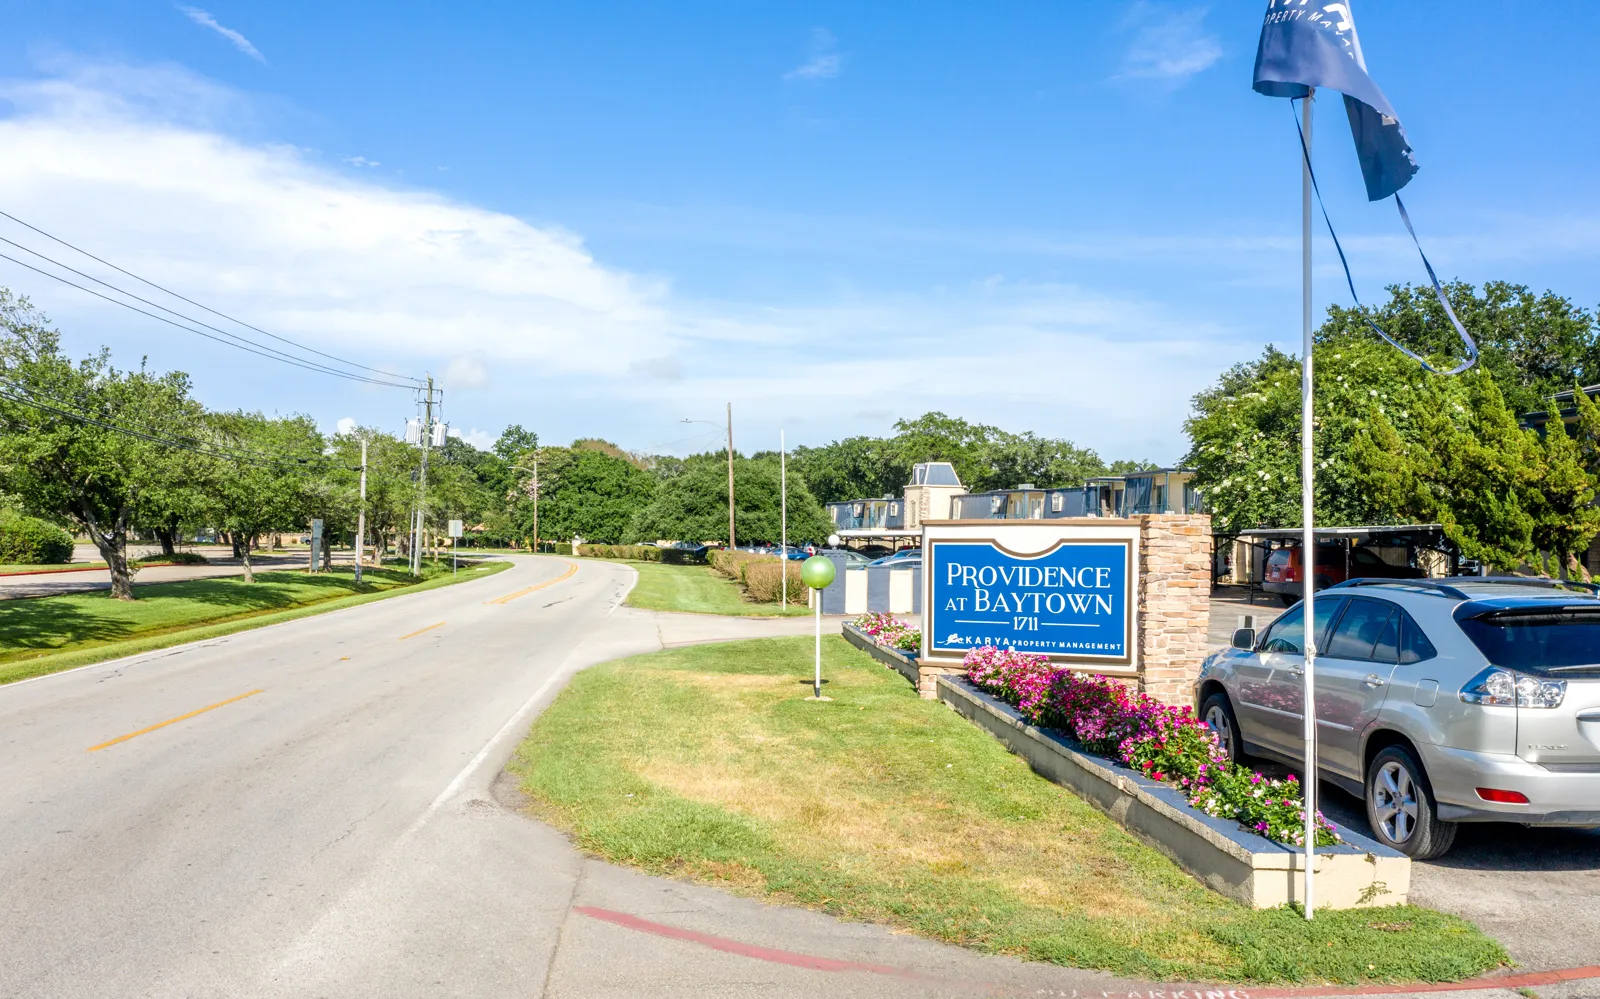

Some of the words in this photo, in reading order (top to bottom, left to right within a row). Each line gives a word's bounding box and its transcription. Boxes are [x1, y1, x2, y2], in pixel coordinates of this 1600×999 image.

[946, 562, 1111, 588] PROVIDENCE
[944, 597, 968, 611] AT
[974, 588, 1113, 615] BAYTOWN
[1013, 616, 1039, 631] 1711
[965, 636, 1010, 646] KARYA
[1012, 640, 1056, 648] PROPERTY
[1059, 641, 1122, 650] MANAGEMENT
